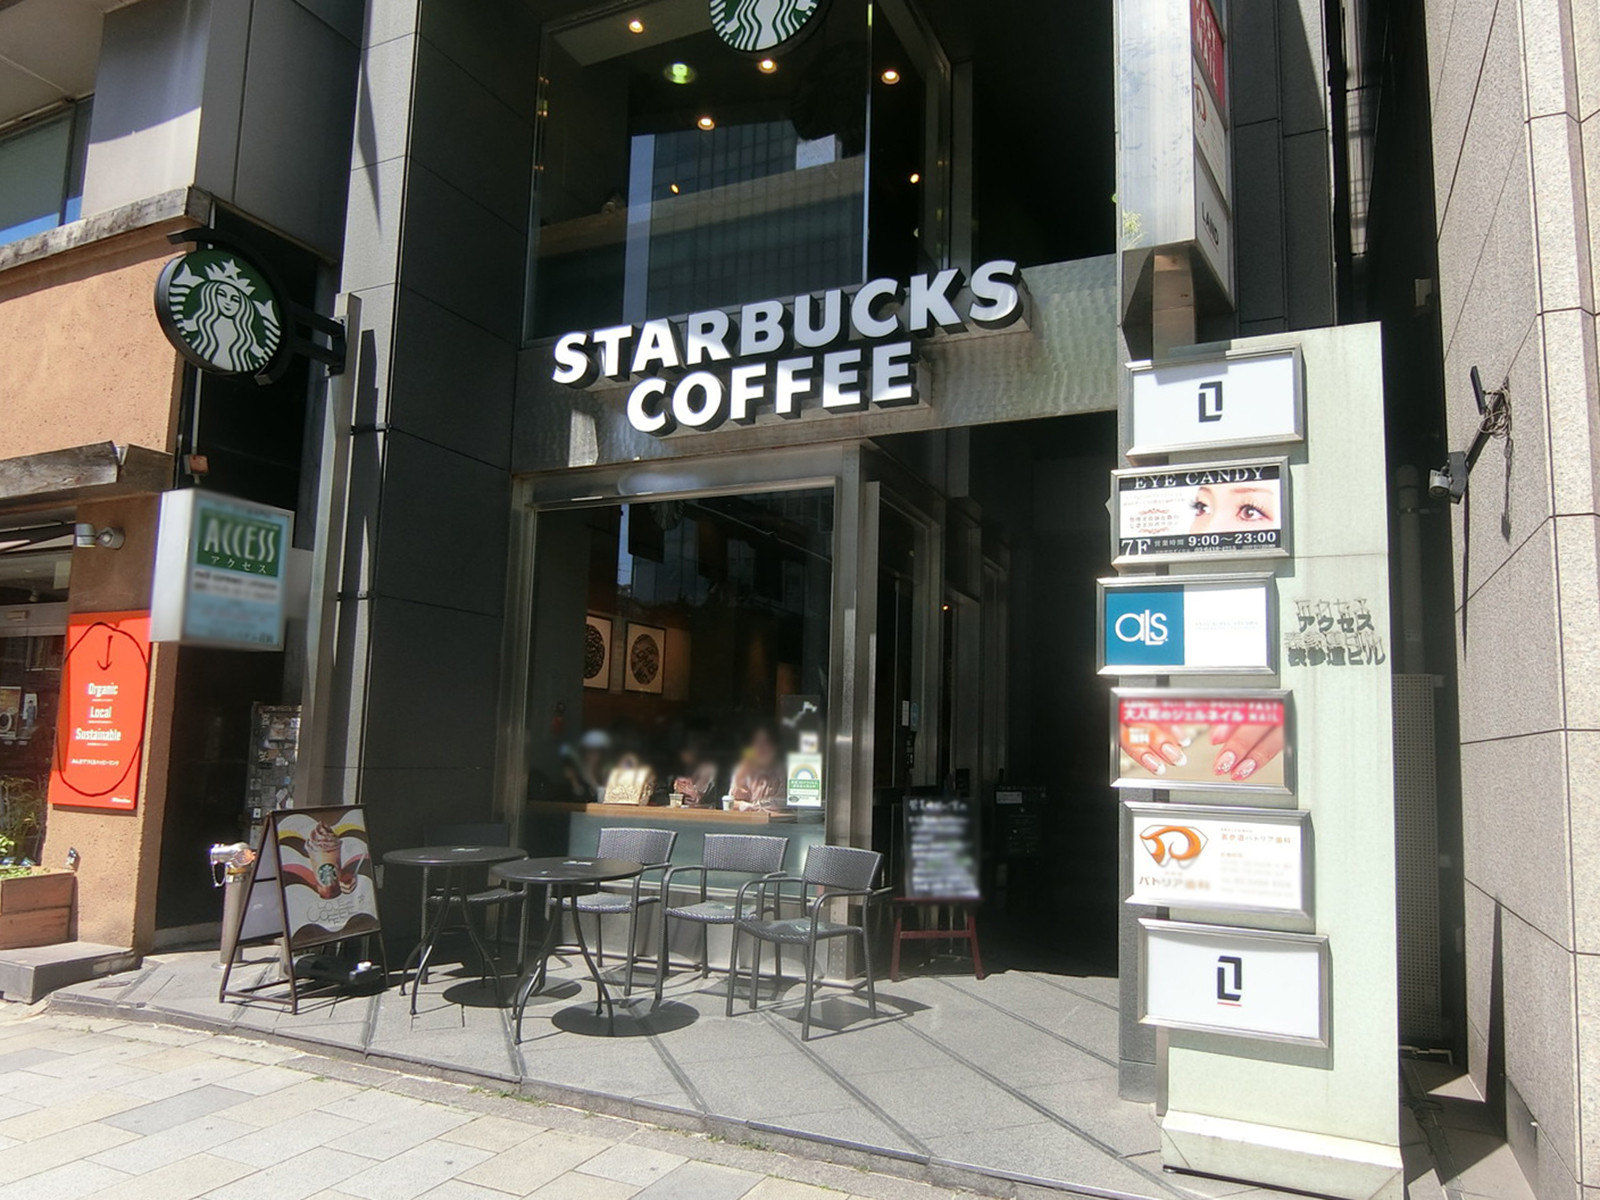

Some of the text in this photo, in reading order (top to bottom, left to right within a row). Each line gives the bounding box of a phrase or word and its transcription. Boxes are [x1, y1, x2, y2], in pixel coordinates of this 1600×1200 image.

[551, 259, 1025, 385] STARBUCKS
[626, 341, 914, 434] COFFEE
[1134, 466, 1264, 489] EYE CANDY
[204, 516, 275, 563] ACCESS
[1121, 539, 1151, 556] 7F
[211, 555, 267, 574] アクセス
[1297, 613, 1375, 633] アクセス
[87, 682, 119, 698] Organic
[89, 705, 112, 719] Local
[75, 727, 122, 742] Sustainable
